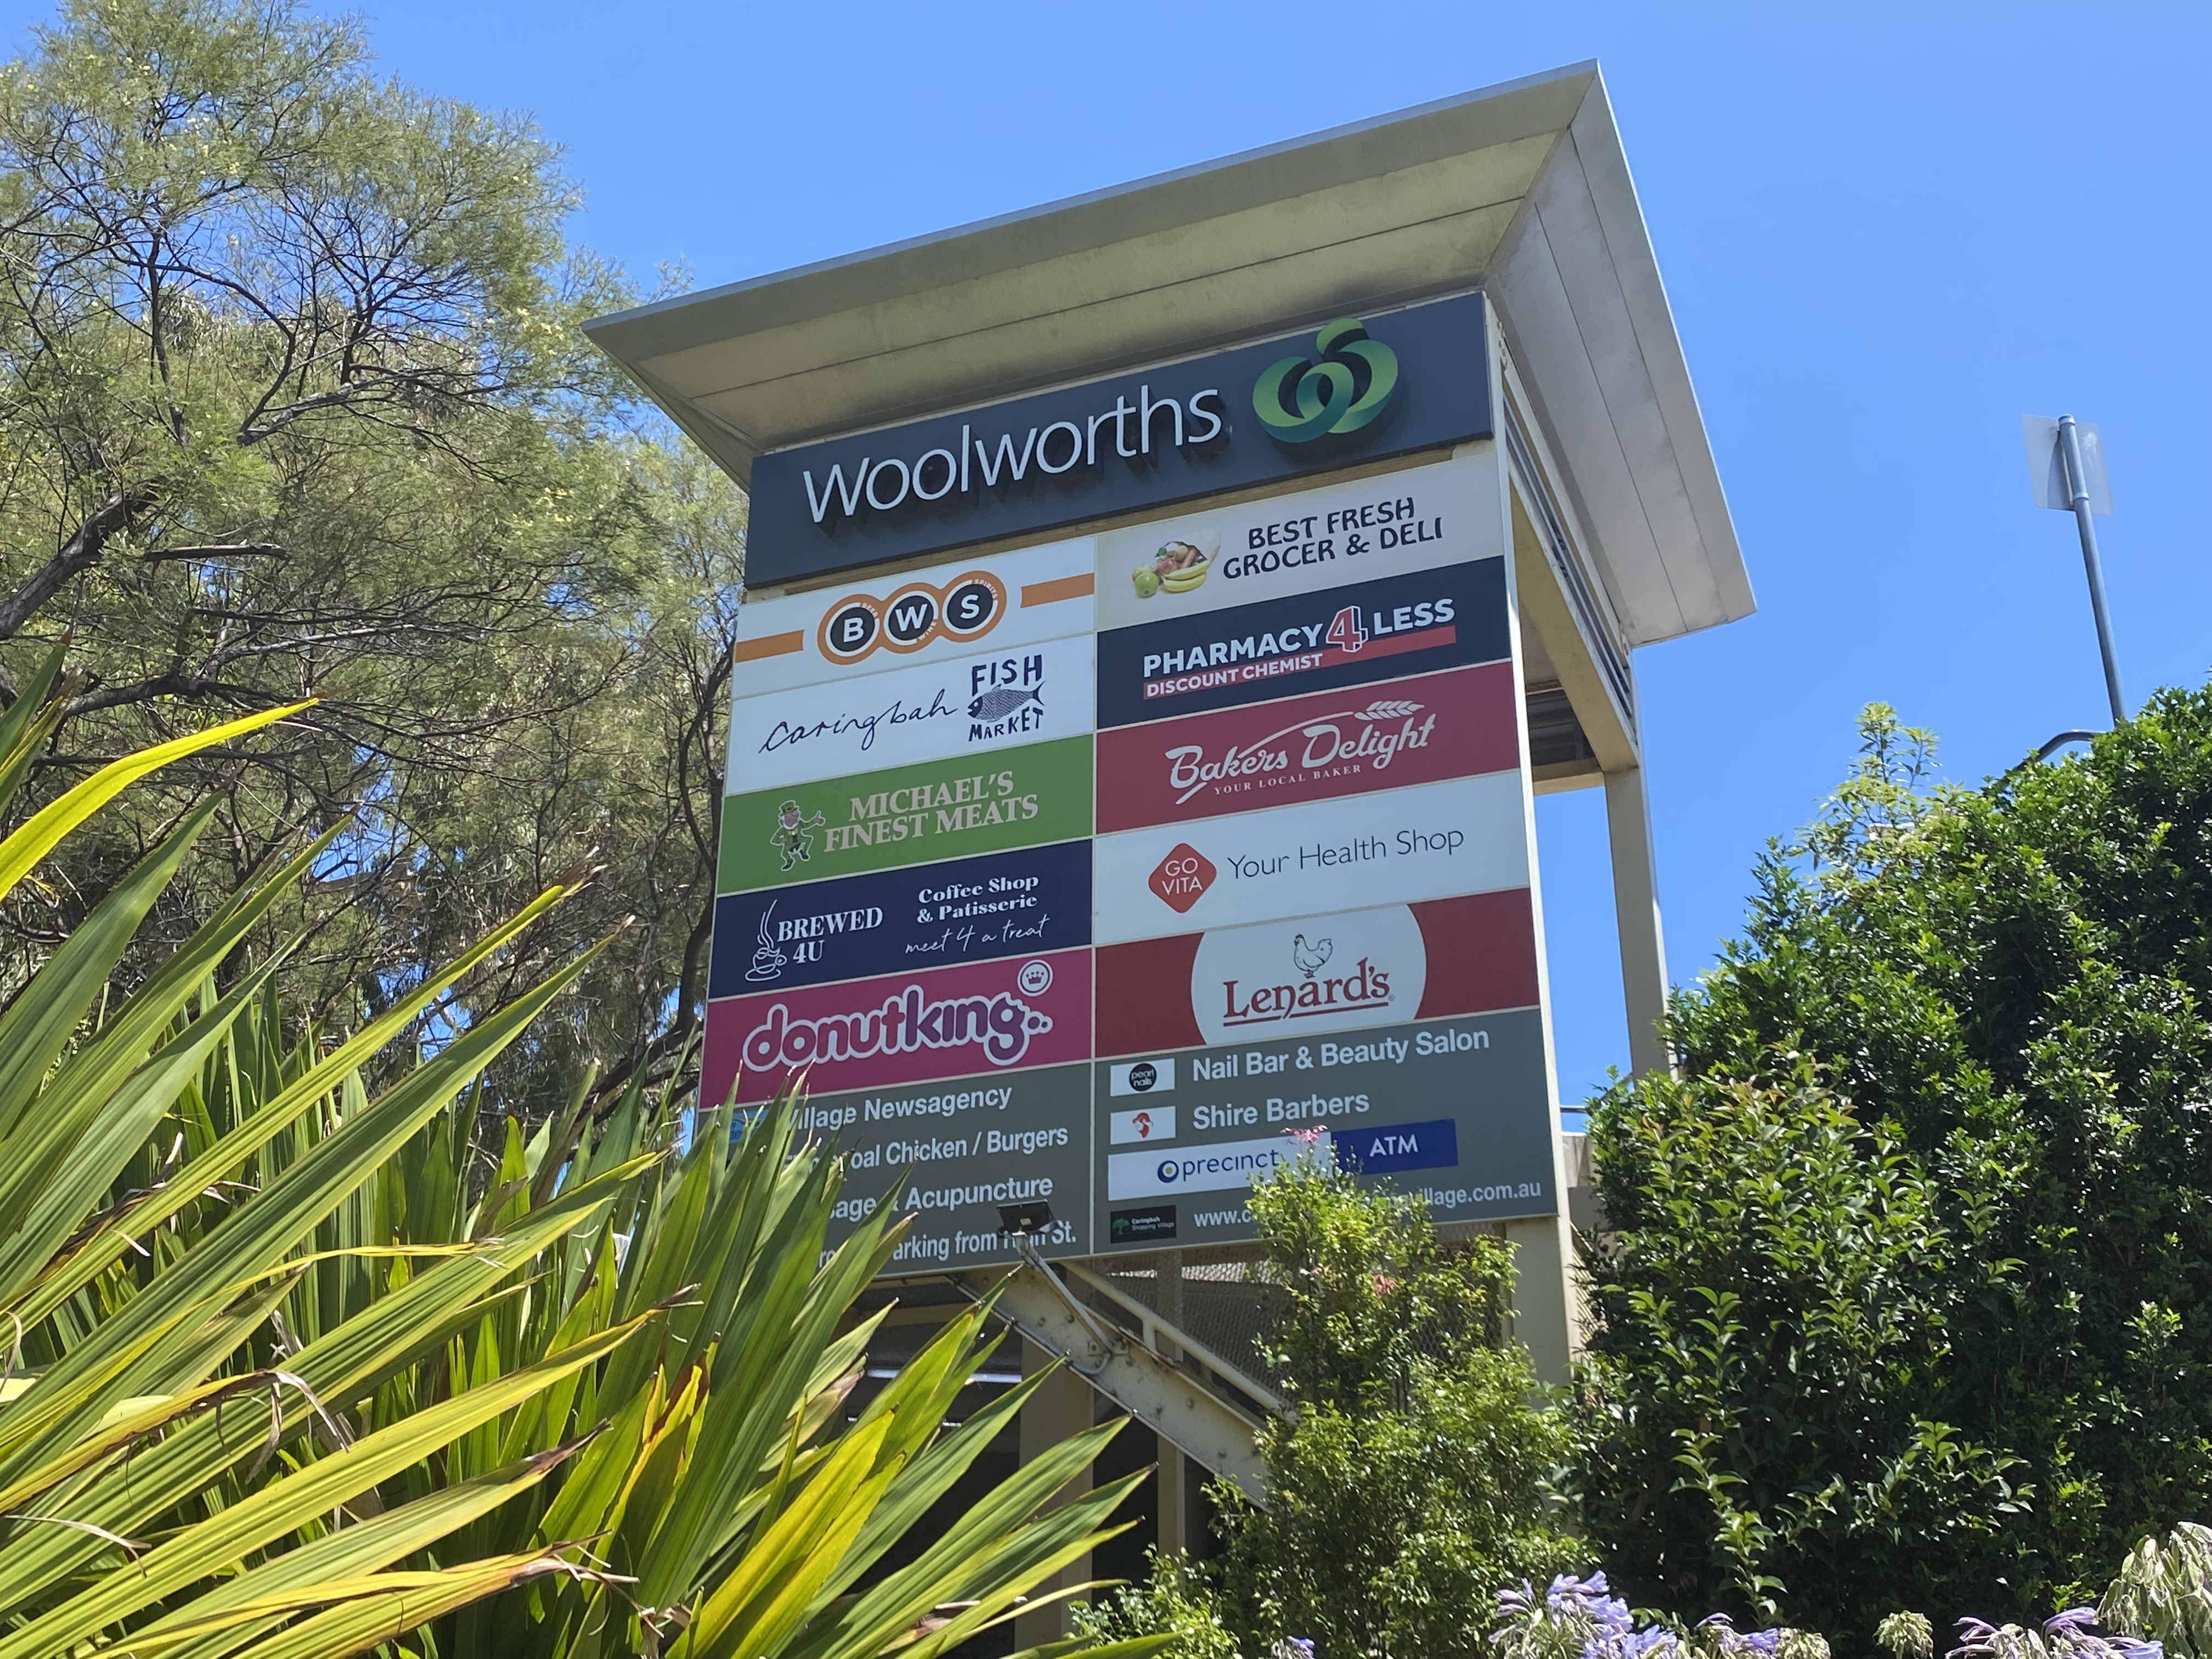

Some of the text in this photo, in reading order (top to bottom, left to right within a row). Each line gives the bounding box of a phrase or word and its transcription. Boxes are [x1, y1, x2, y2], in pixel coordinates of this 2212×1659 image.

[803, 384, 1222, 522] Woolworths
[1249, 498, 1414, 549] BEST FRESH
[1223, 517, 1442, 579] GROCER & DELI
[973, 579, 998, 599] SPIRITS
[861, 603, 878, 619] BEER
[917, 621, 937, 641] WINE
[1143, 598, 1454, 678] PHARMACY 4 LESS
[971, 653, 1043, 697] FISH
[1147, 653, 1323, 697] DISCOUNT CHEMIST
[968, 707, 1044, 742] MARKET
[1165, 714, 1436, 789] Bakers Delight
[849, 771, 1013, 821] MICHAEL'S
[1215, 764, 1362, 796] YOUR LOCAL BAKER
[823, 794, 1038, 852] FINEST MEATS
[1165, 857, 1199, 877] GO
[1227, 829, 1464, 879] Your Health Shop
[918, 877, 1039, 904] Coffee Shop
[1161, 876, 1203, 895] VITA
[777, 907, 883, 943] BREWED
[917, 894, 1038, 923] & Patisserie
[905, 913, 1051, 954] meet 4 a treat
[792, 940, 824, 964] 4U
[1223, 956, 1390, 1019] Lenard's
[743, 985, 1031, 1071] donutking
[1193, 1029, 1489, 1082] Nail Bar & Beauty Salon
[1131, 1068, 1154, 1081] pearl
[864, 1087, 1012, 1122] Newsagency
[1193, 1094, 1370, 1130] Shire Barbers
[885, 1137, 967, 1165] Chicken
[972, 1131, 981, 1156] /
[987, 1127, 1069, 1156] Burgers
[1369, 1133, 1419, 1156] ATM
[1183, 1149, 1280, 1182] precinct
[905, 1177, 1054, 1211] Acupuncture
[893, 1230, 950, 1261] arking
[955, 1231, 997, 1254] from
